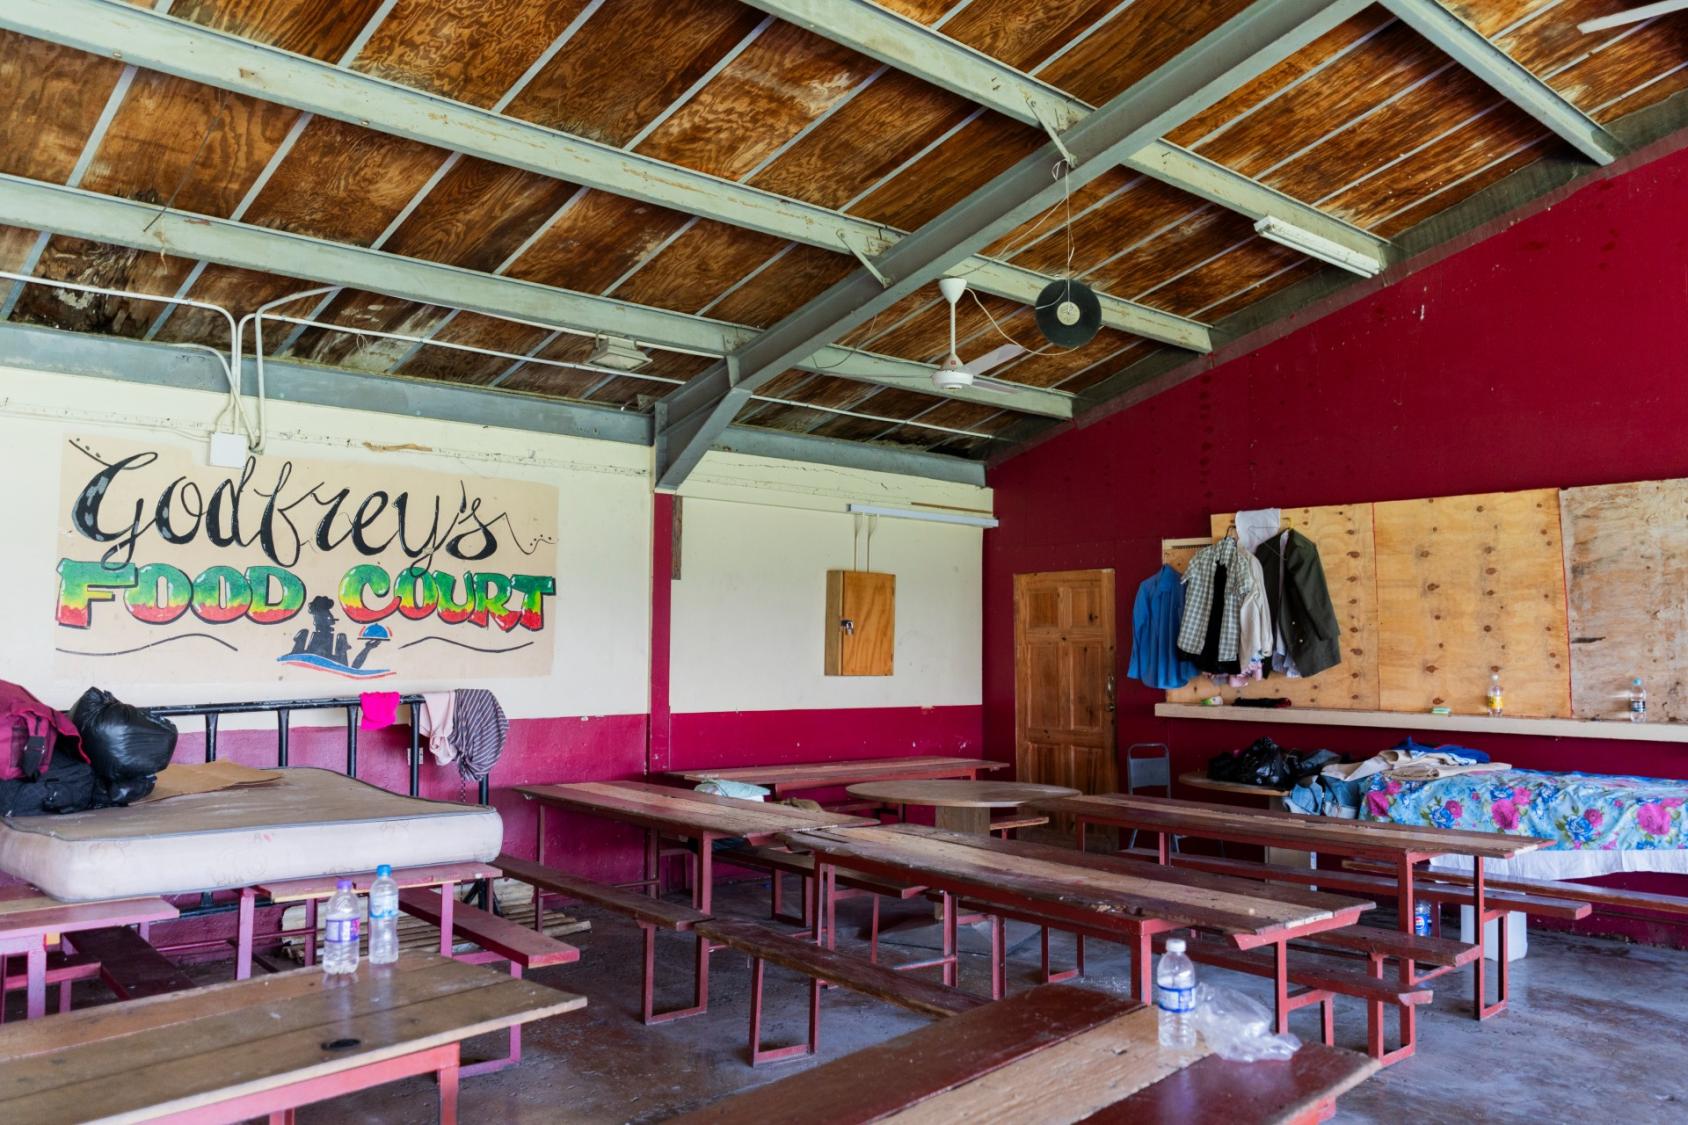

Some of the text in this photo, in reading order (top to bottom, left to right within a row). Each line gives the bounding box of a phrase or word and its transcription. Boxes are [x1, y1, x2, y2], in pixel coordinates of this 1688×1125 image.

[70, 444, 504, 577] Godfrey's
[56, 557, 556, 632] FOOD COURT
